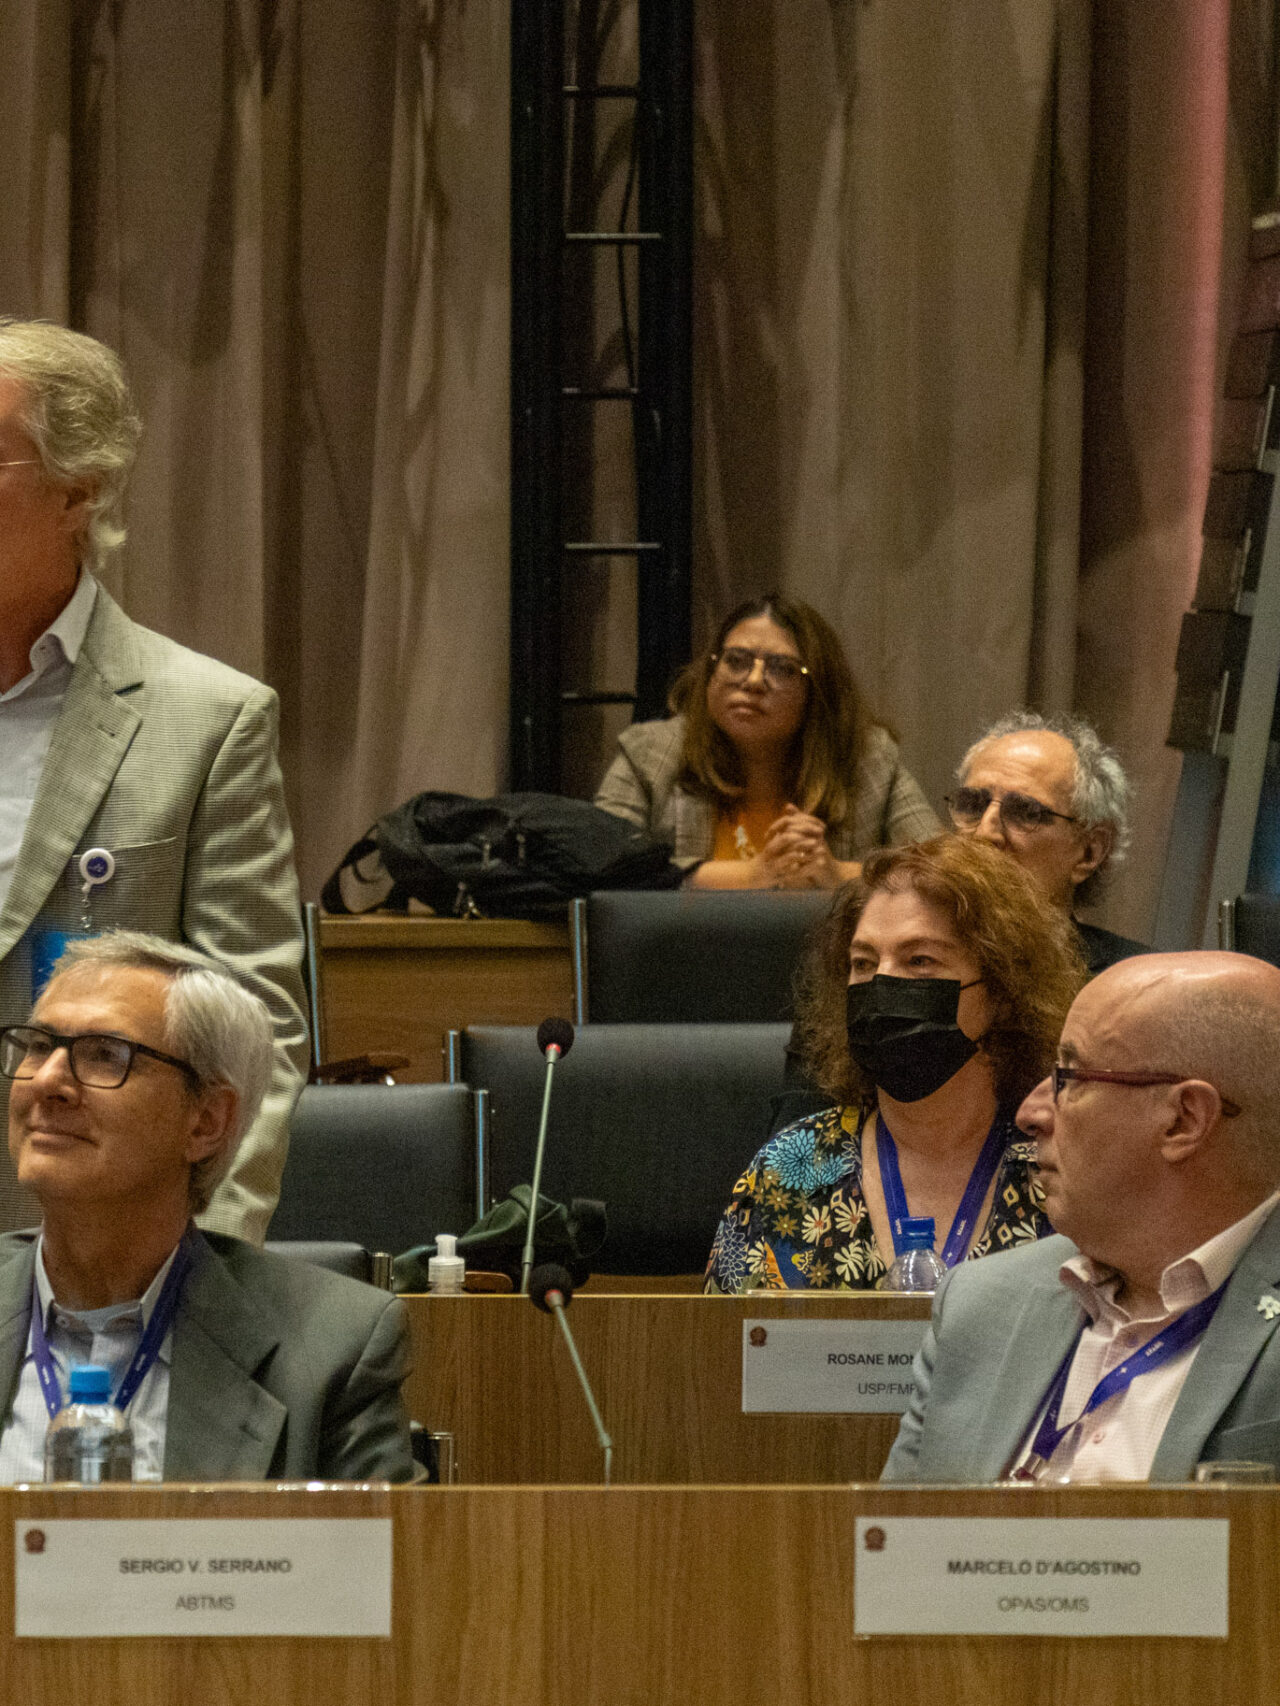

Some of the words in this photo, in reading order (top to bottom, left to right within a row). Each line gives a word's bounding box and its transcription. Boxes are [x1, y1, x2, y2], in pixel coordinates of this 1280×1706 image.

[827, 1354, 884, 1365] ROSANE
[120, 1560, 184, 1573] SERGIO
[208, 1560, 291, 1573] SERRANO
[947, 1561, 1032, 1575] MARCELO
[1035, 1561, 1141, 1575] D'AGOSTINO
[175, 1597, 235, 1611] ABTMS
[998, 1597, 1090, 1612] OPAS/OMS
